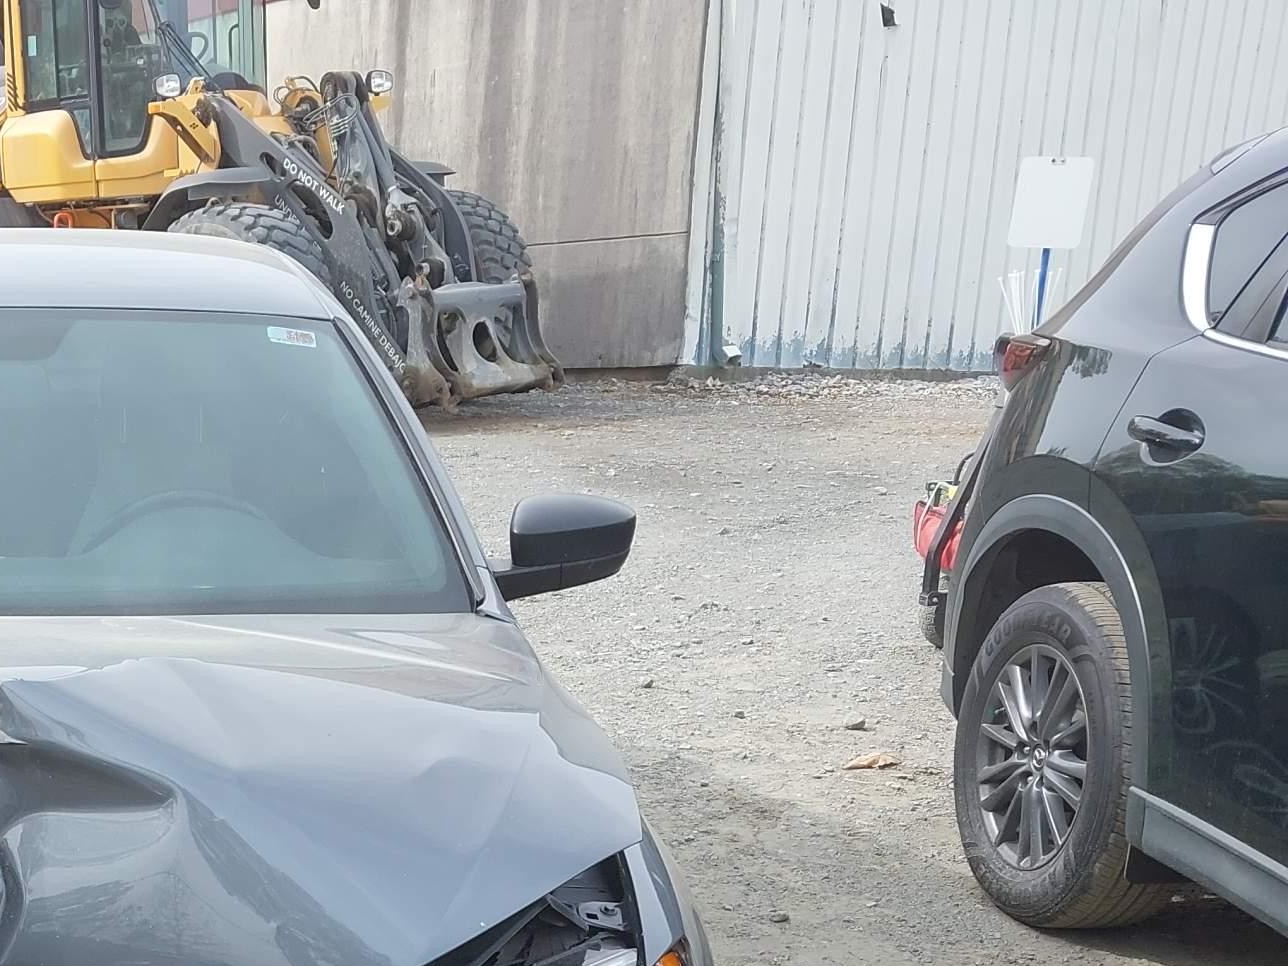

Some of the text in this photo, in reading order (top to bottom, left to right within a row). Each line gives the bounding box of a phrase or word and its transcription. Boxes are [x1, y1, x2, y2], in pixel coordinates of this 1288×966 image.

[283, 158, 345, 215] DO NOT WALK
[340, 280, 354, 299] NO
[353, 299, 381, 337] CAMINE
